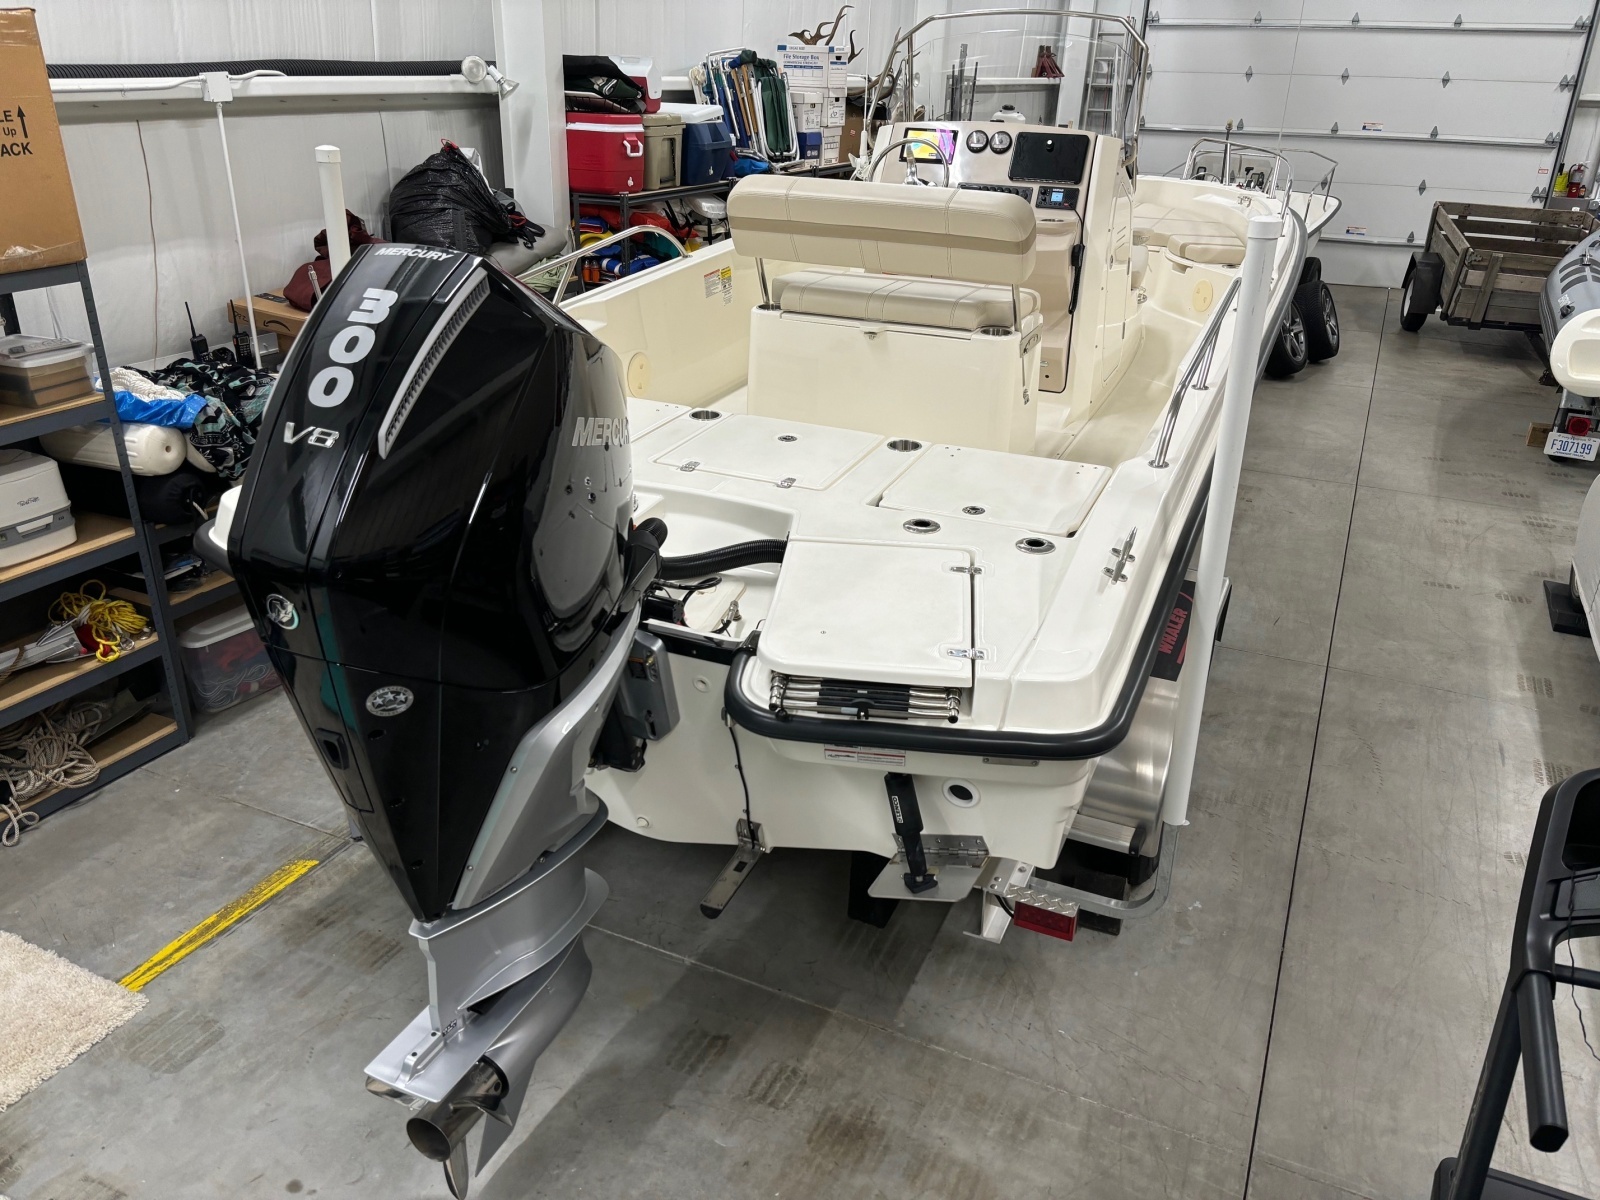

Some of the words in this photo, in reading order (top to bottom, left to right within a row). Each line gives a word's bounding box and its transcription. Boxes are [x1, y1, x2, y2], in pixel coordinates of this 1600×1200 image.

[3, 126, 17, 138] Up
[1, 142, 33, 157] ACK
[374, 247, 454, 261] MERCURY
[308, 288, 399, 408] 300
[283, 421, 340, 448] V8
[571, 416, 630, 447] MERCUR
[1551, 438, 1593, 455] F307199
[1158, 607, 1188, 654] WHALER
